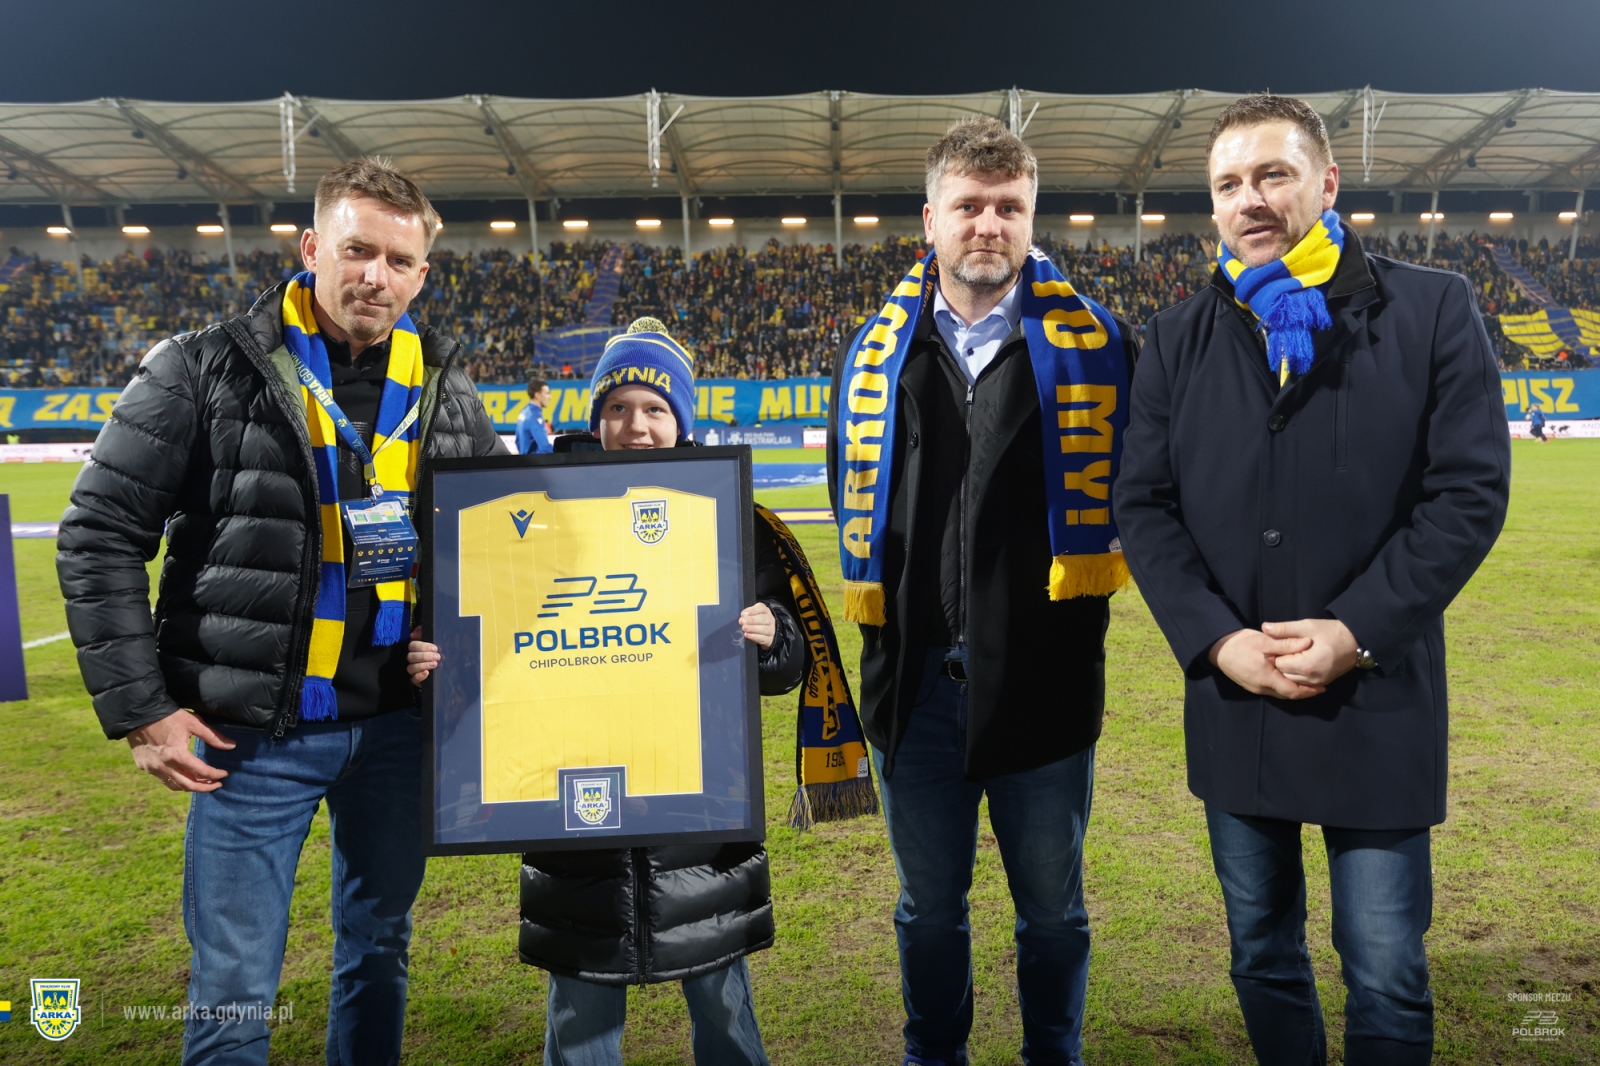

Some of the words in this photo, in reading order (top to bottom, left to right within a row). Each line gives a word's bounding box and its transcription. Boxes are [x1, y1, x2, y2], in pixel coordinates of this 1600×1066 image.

[307, 380, 334, 407] ARKA
[1056, 383, 1117, 526] MY!
[513, 622, 671, 654] POLBROK
[529, 655, 608, 669] CHIPOLBROK
[610, 652, 654, 665] GROUP
